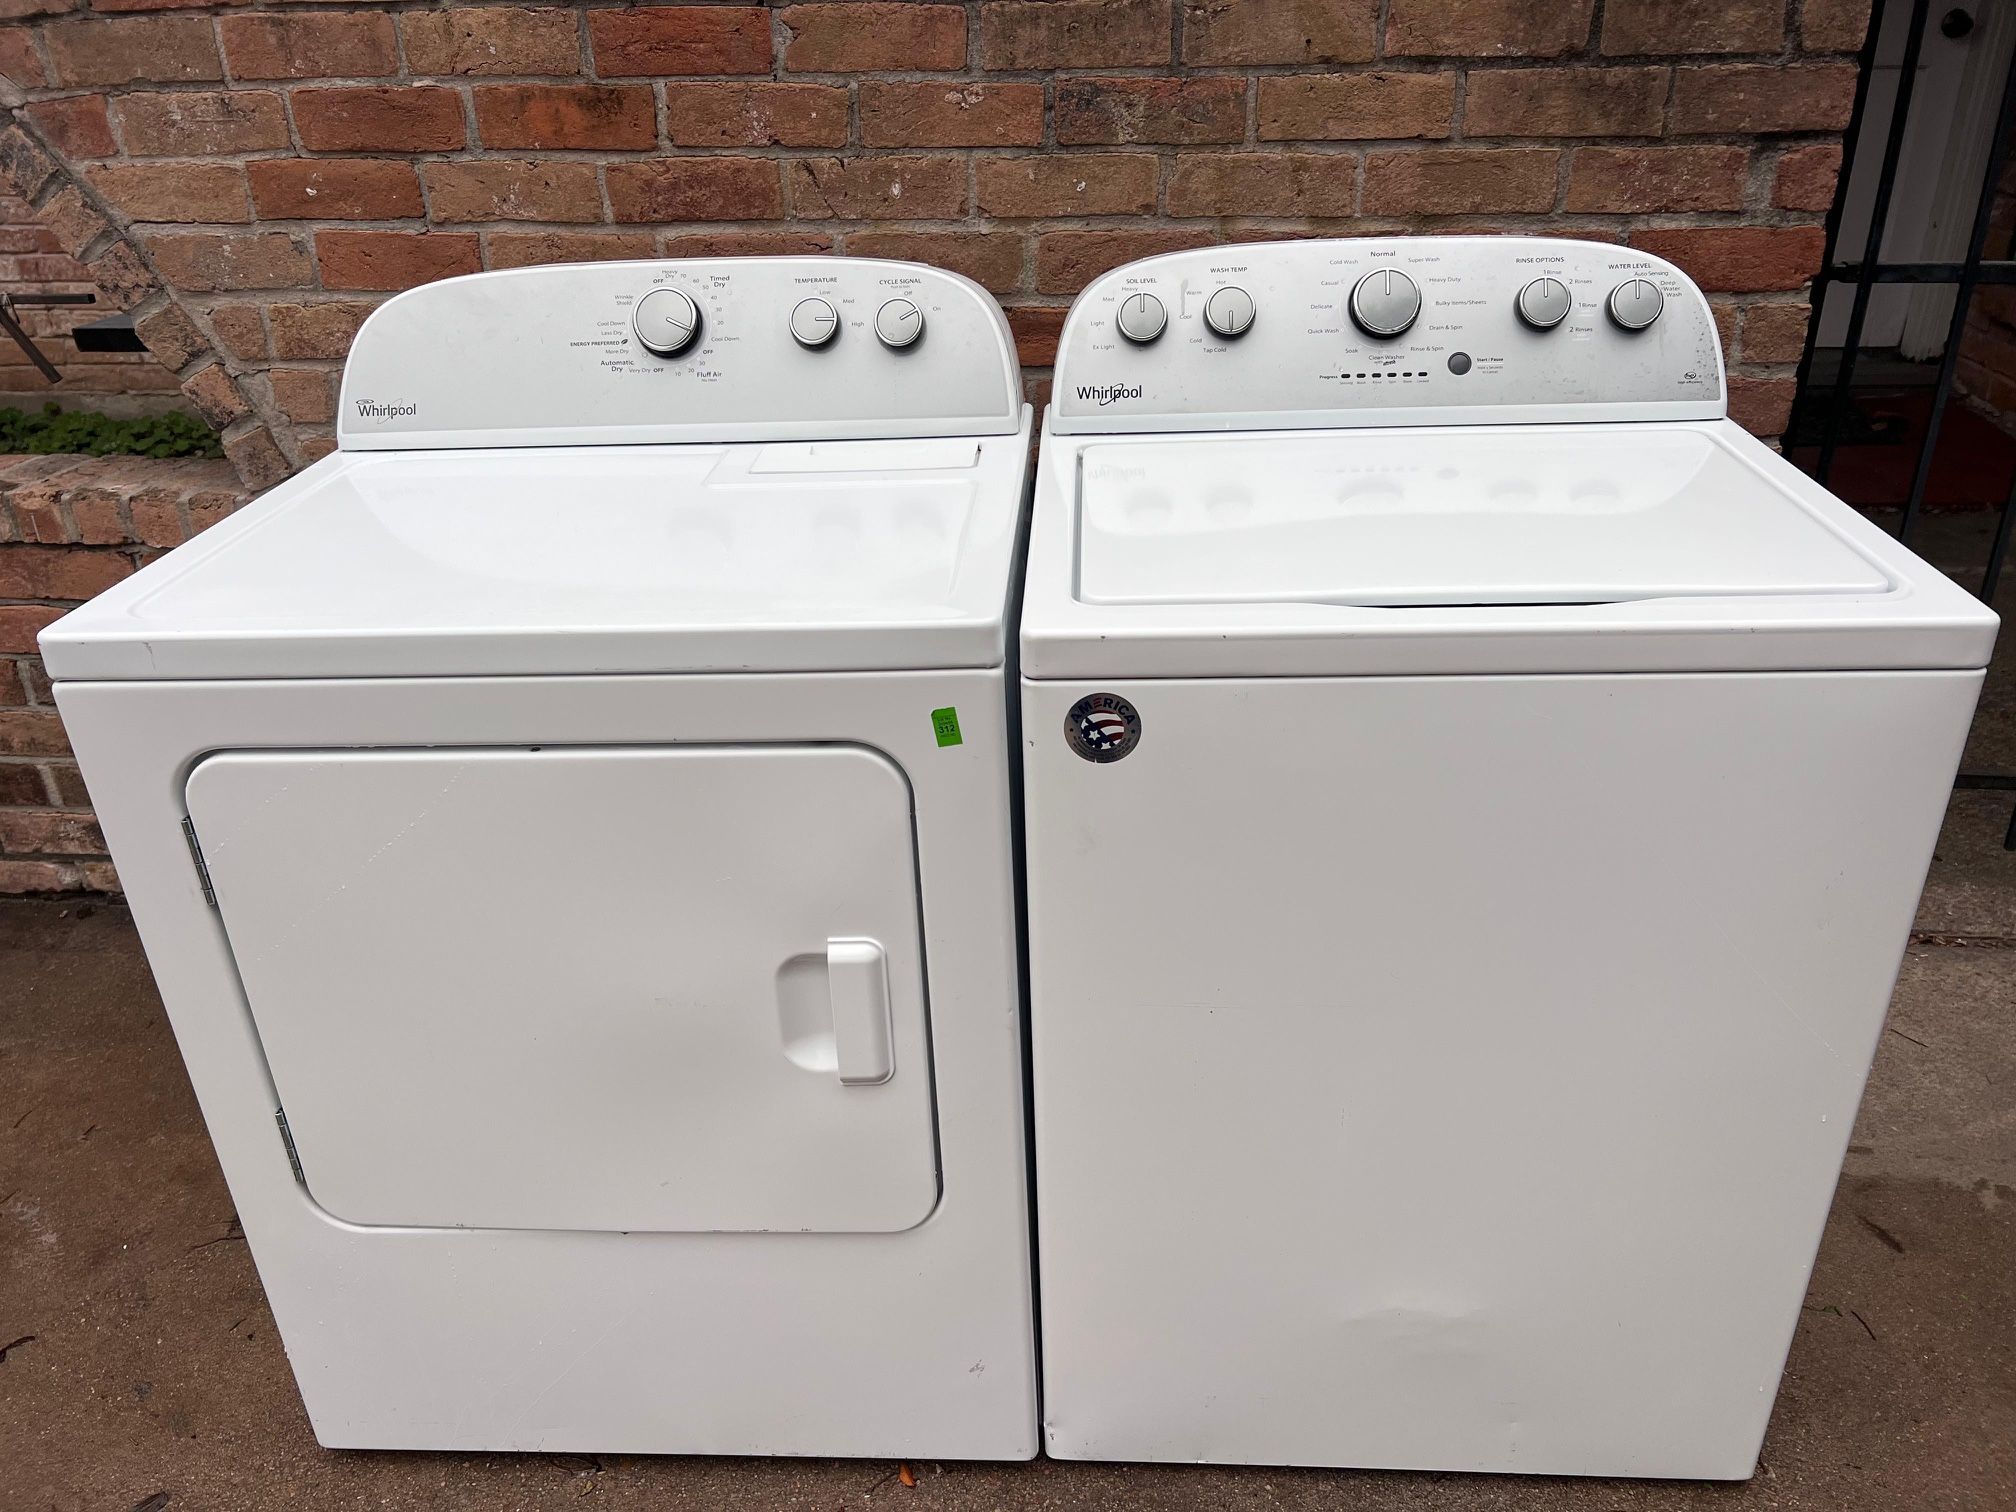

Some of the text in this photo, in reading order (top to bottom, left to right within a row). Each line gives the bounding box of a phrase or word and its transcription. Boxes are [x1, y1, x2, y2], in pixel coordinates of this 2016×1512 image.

[1076, 384, 1142, 404] Whirlpool
[358, 402, 416, 420] Whirlpool
[1070, 697, 1136, 725] AMERICA
[938, 724, 955, 734] 312
